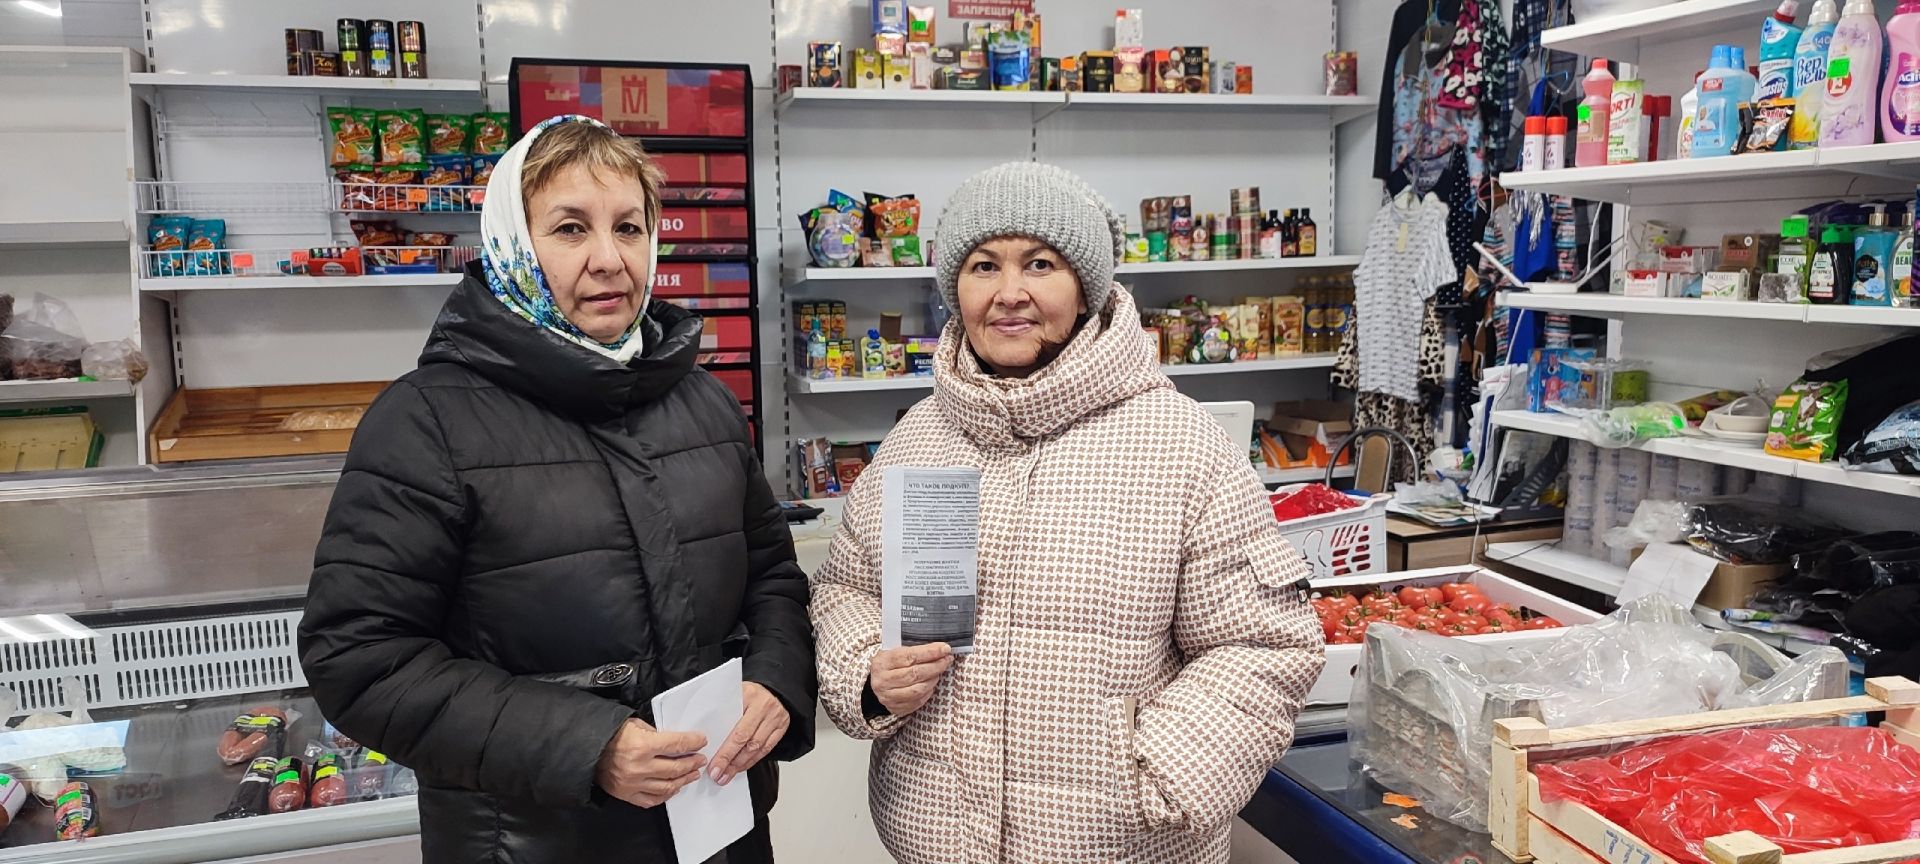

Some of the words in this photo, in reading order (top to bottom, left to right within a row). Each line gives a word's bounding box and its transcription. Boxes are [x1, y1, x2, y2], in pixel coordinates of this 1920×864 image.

[956, 5, 1025, 17] ЗАПРЕЩЕН!
[1899, 70, 1920, 83] Acti
[661, 218, 684, 231] ВО
[655, 274, 681, 287] ИЯ
